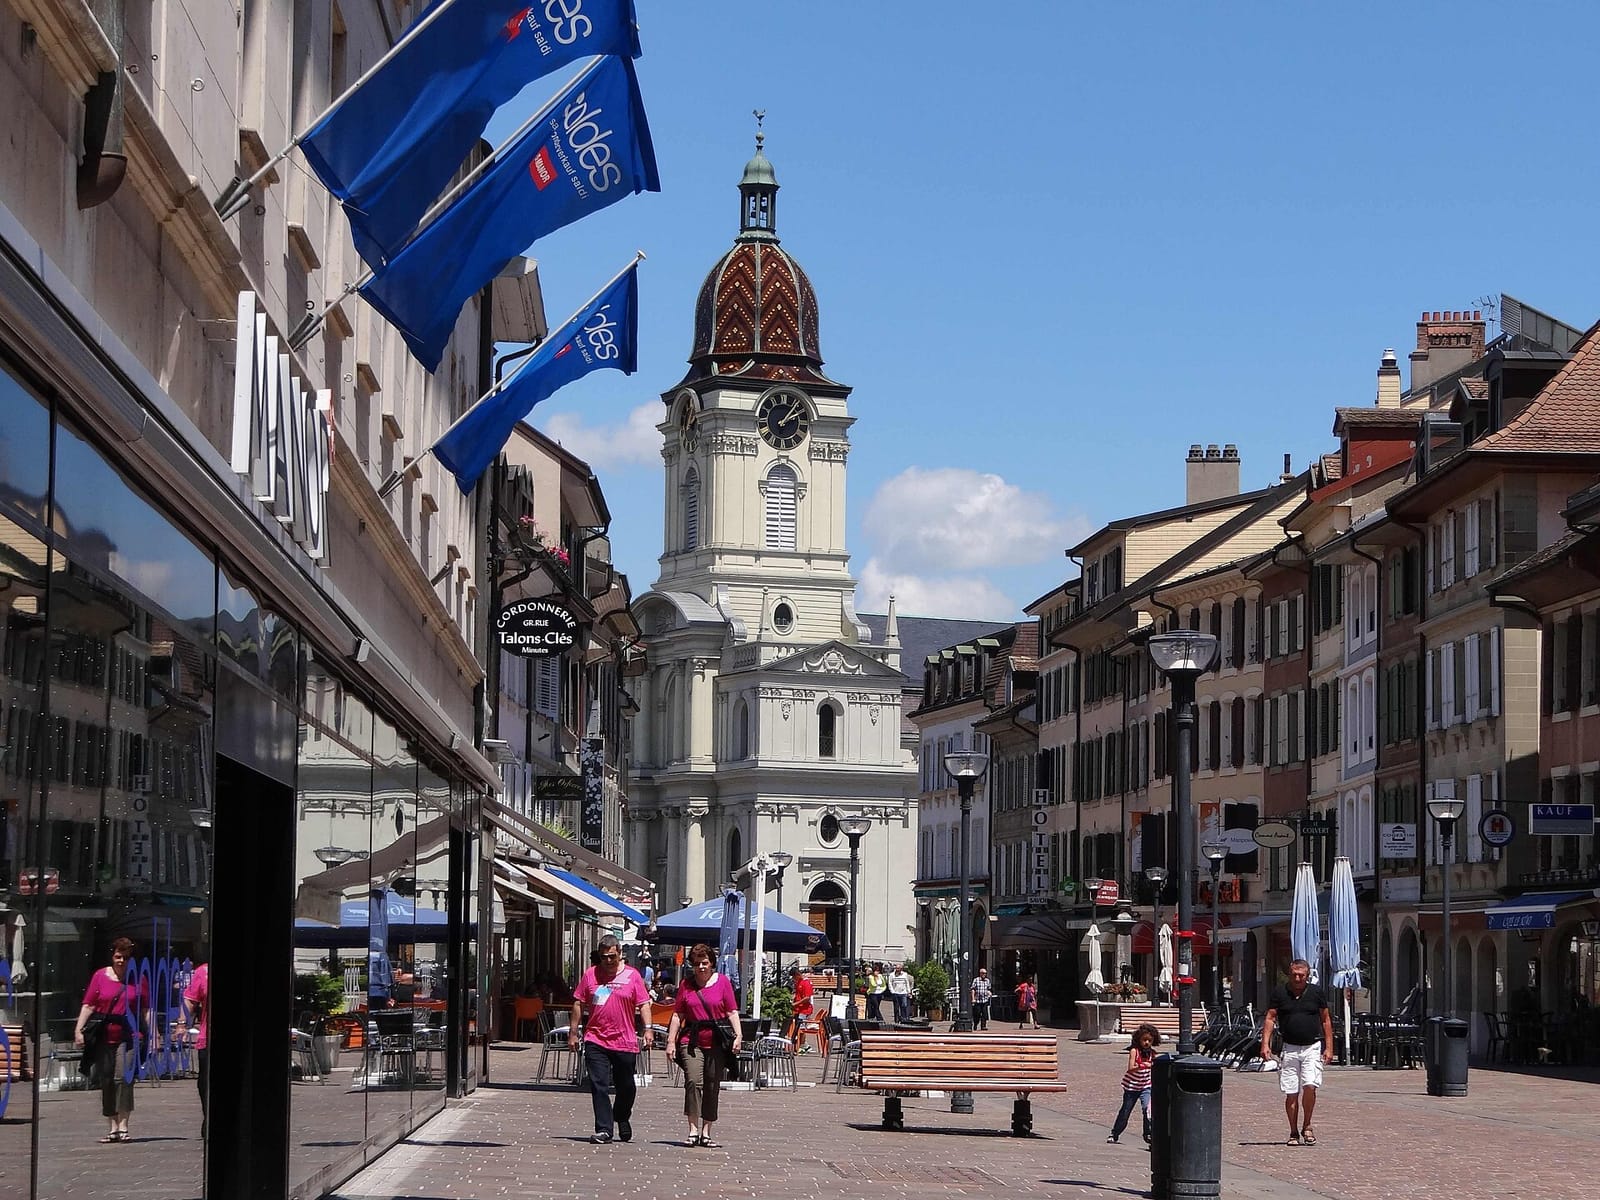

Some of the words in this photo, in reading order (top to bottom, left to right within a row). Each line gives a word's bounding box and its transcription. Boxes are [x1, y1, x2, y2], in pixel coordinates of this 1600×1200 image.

[496, 602, 577, 629] CORDONNERIE
[521, 646, 549, 654] Minutes
[1537, 806, 1573, 815] KAUF
[1034, 789, 1048, 889] HOTEL
